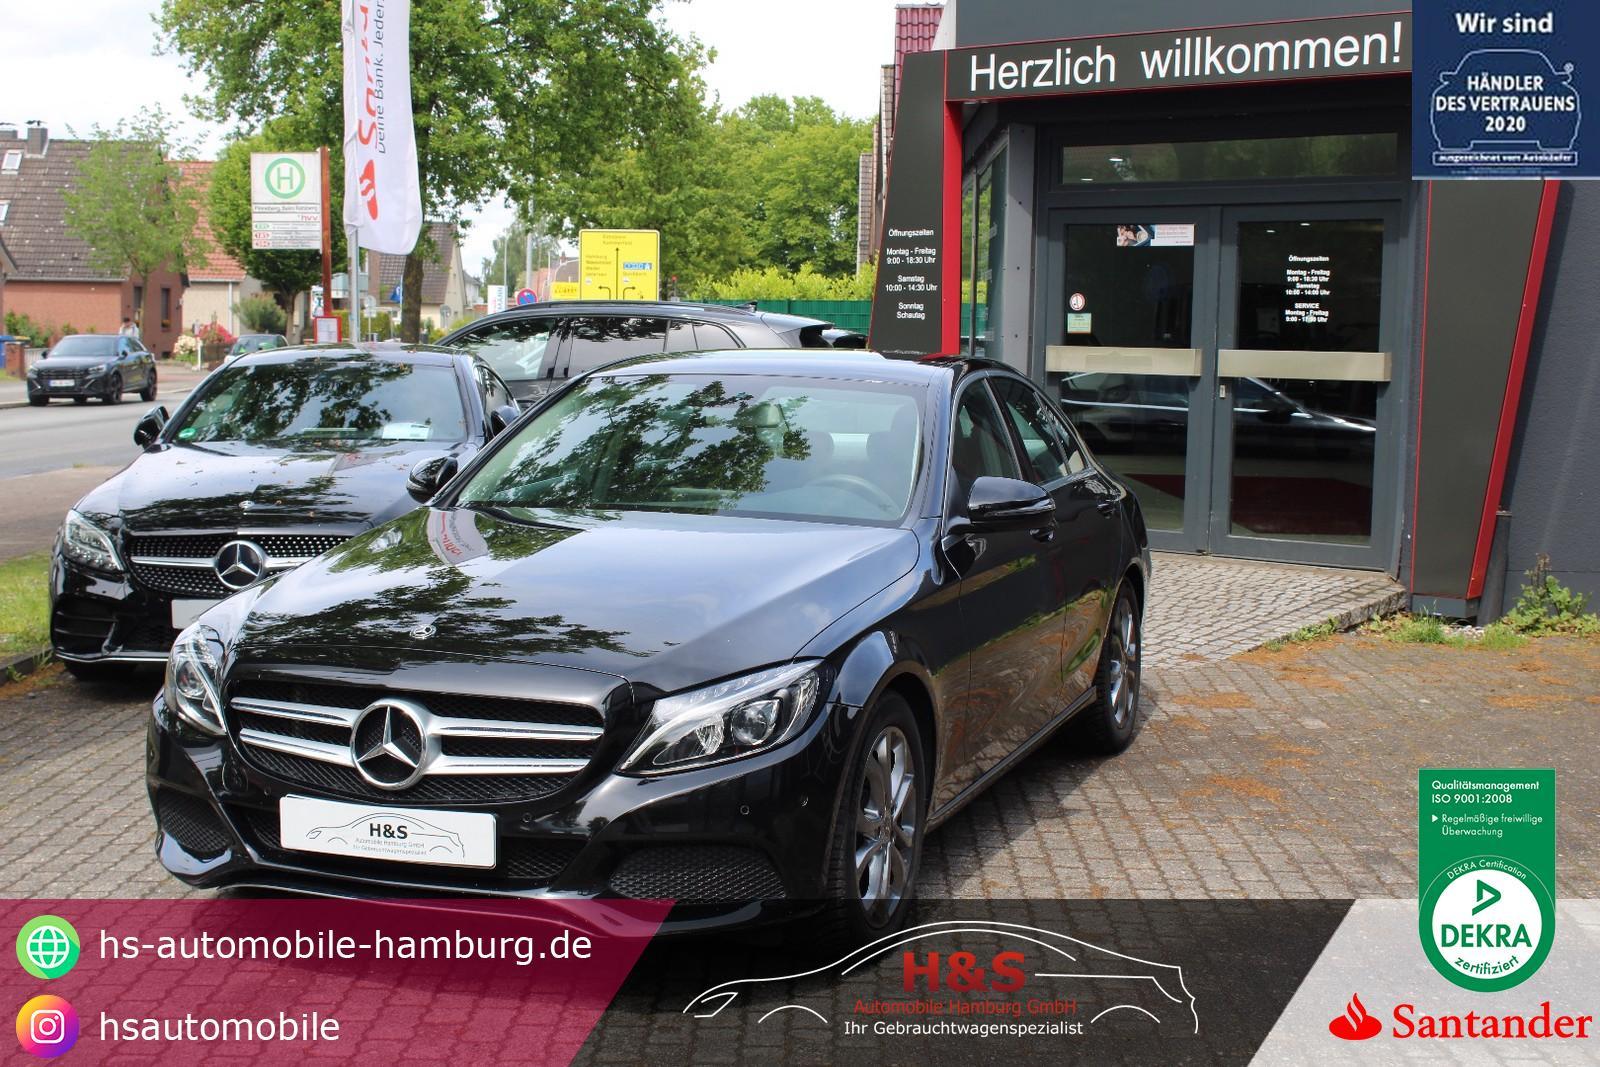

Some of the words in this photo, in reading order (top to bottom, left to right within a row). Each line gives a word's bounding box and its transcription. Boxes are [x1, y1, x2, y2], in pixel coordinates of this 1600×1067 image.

[373, 0, 384, 46] Jeder
[970, 45, 1116, 91] Herzlich
[1141, 21, 1402, 79] willkommen!
[373, 54, 384, 100] Bank.
[277, 167, 293, 189] H
[888, 228, 934, 238] Öffnungszeiten
[886, 248, 910, 256] Montag
[914, 247, 936, 256] Freitag
[886, 257, 900, 265] 9:00
[906, 256, 923, 264] 18:30
[924, 256, 936, 264] Uhr
[1286, 269, 1307, 277] Montag
[1310, 269, 1331, 277] Freitag
[897, 274, 925, 283] Samstag
[885, 284, 903, 292] 10:00
[908, 284, 925, 292] 14:30
[898, 302, 924, 310] Sonntag
[896, 311, 926, 320] Schautag
[1285, 309, 1306, 317] Montag
[1309, 309, 1329, 317] Freitag
[369, 823, 408, 840] H&S
